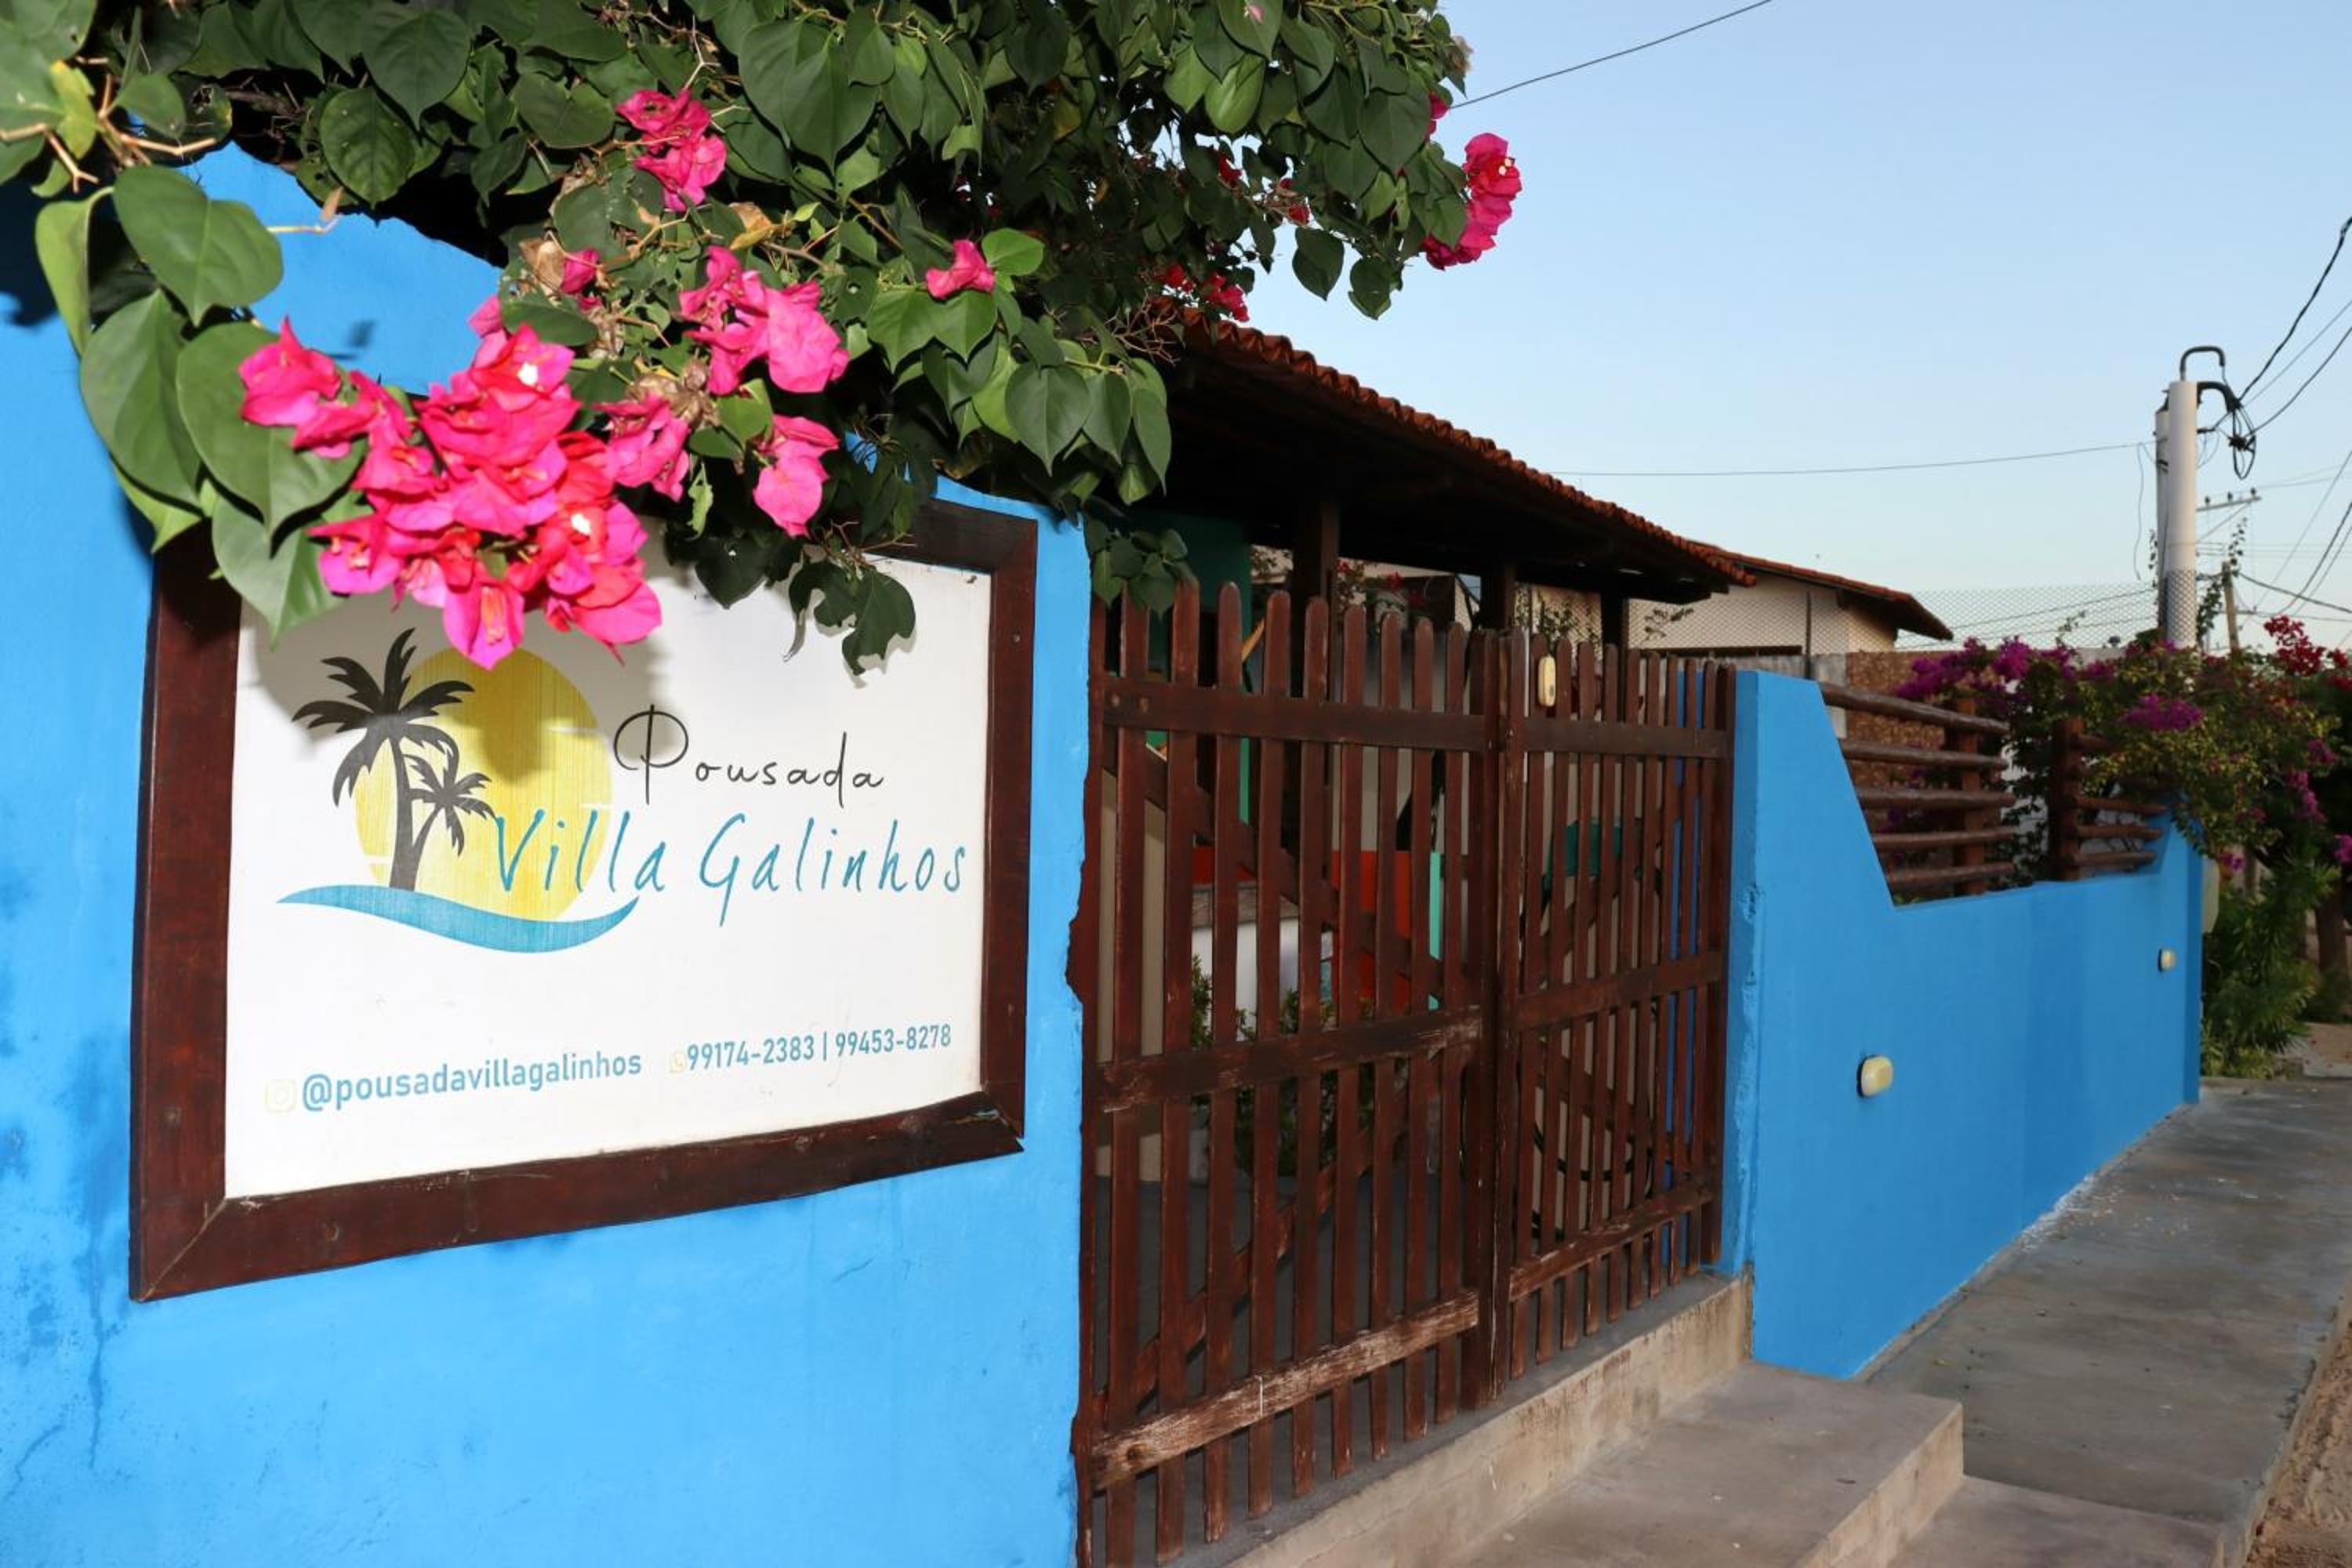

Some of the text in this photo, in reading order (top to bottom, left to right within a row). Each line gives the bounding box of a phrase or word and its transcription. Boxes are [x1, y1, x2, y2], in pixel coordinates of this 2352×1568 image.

[614, 704, 884, 808] Pousada
[495, 808, 966, 927] Villa Galinhos
[302, 1051, 642, 1112] @pousadavillagalinhos
[687, 1035, 815, 1070] 99174-2383
[835, 1023, 952, 1057] 99453-8278
